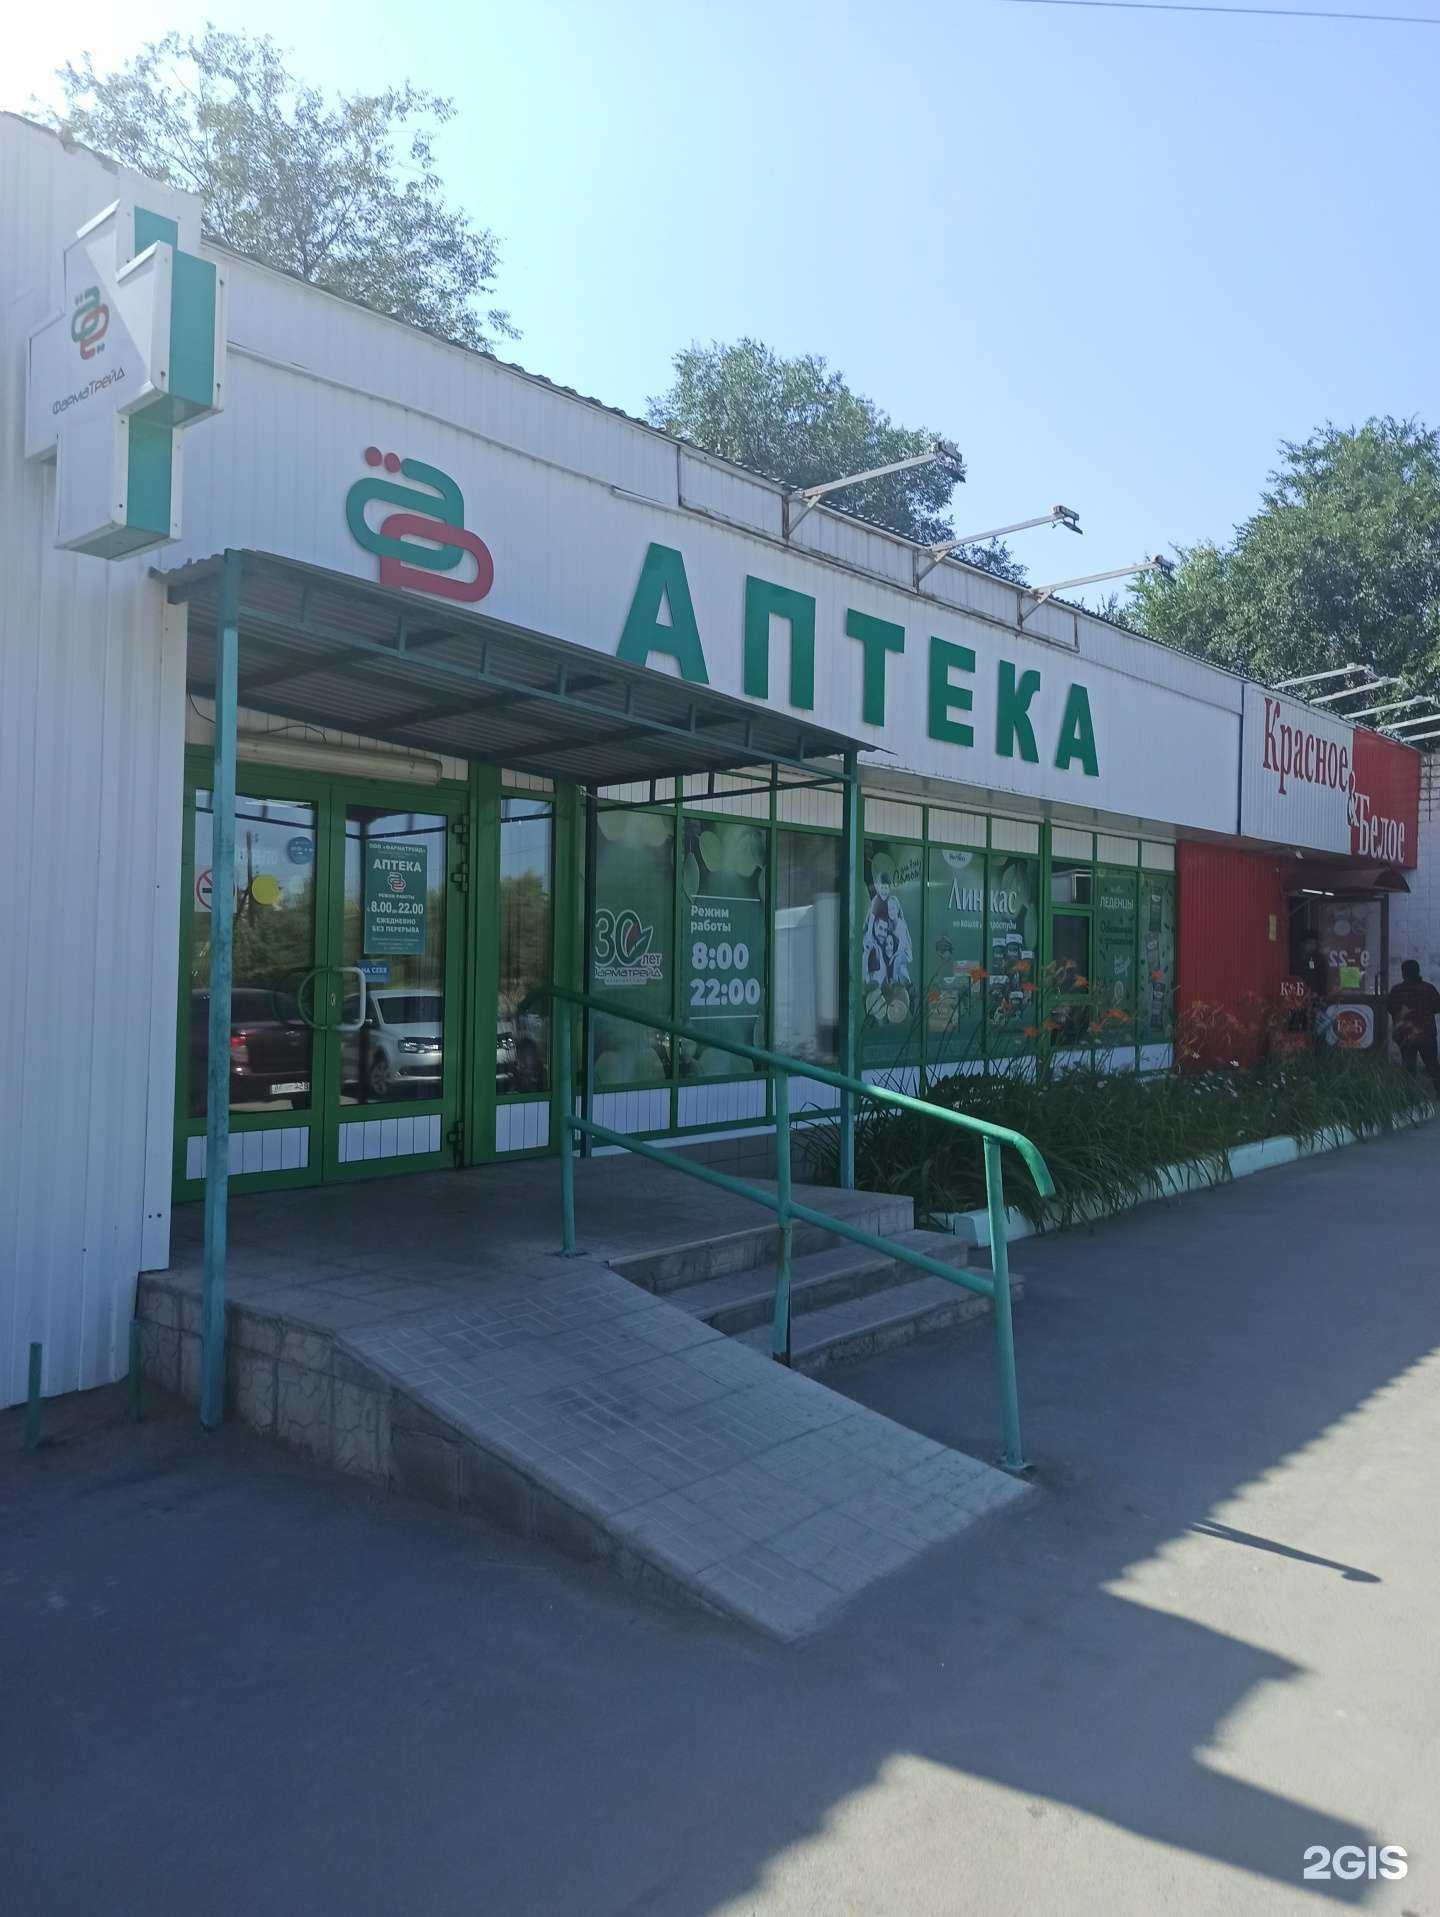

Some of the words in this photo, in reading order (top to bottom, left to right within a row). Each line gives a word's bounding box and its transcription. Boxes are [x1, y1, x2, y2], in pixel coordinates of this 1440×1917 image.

[615, 541, 1100, 777] АПТЕКА
[1262, 698, 1349, 795] Красное
[1358, 793, 1406, 864] Белое
[373, 858, 422, 873] АПТЕКА
[371, 900, 392, 913] 8.00
[398, 902, 424, 915] 22.00
[690, 904, 730, 918] Режим
[376, 916, 416, 926] ЕЖЕДНЕВНО
[385, 926, 420, 934] ПЕРЕРЫВА
[690, 919, 732, 934] работы
[595, 908, 654, 967] 30
[691, 942, 750, 970] 8:00
[689, 977, 761, 1006] 22:00
